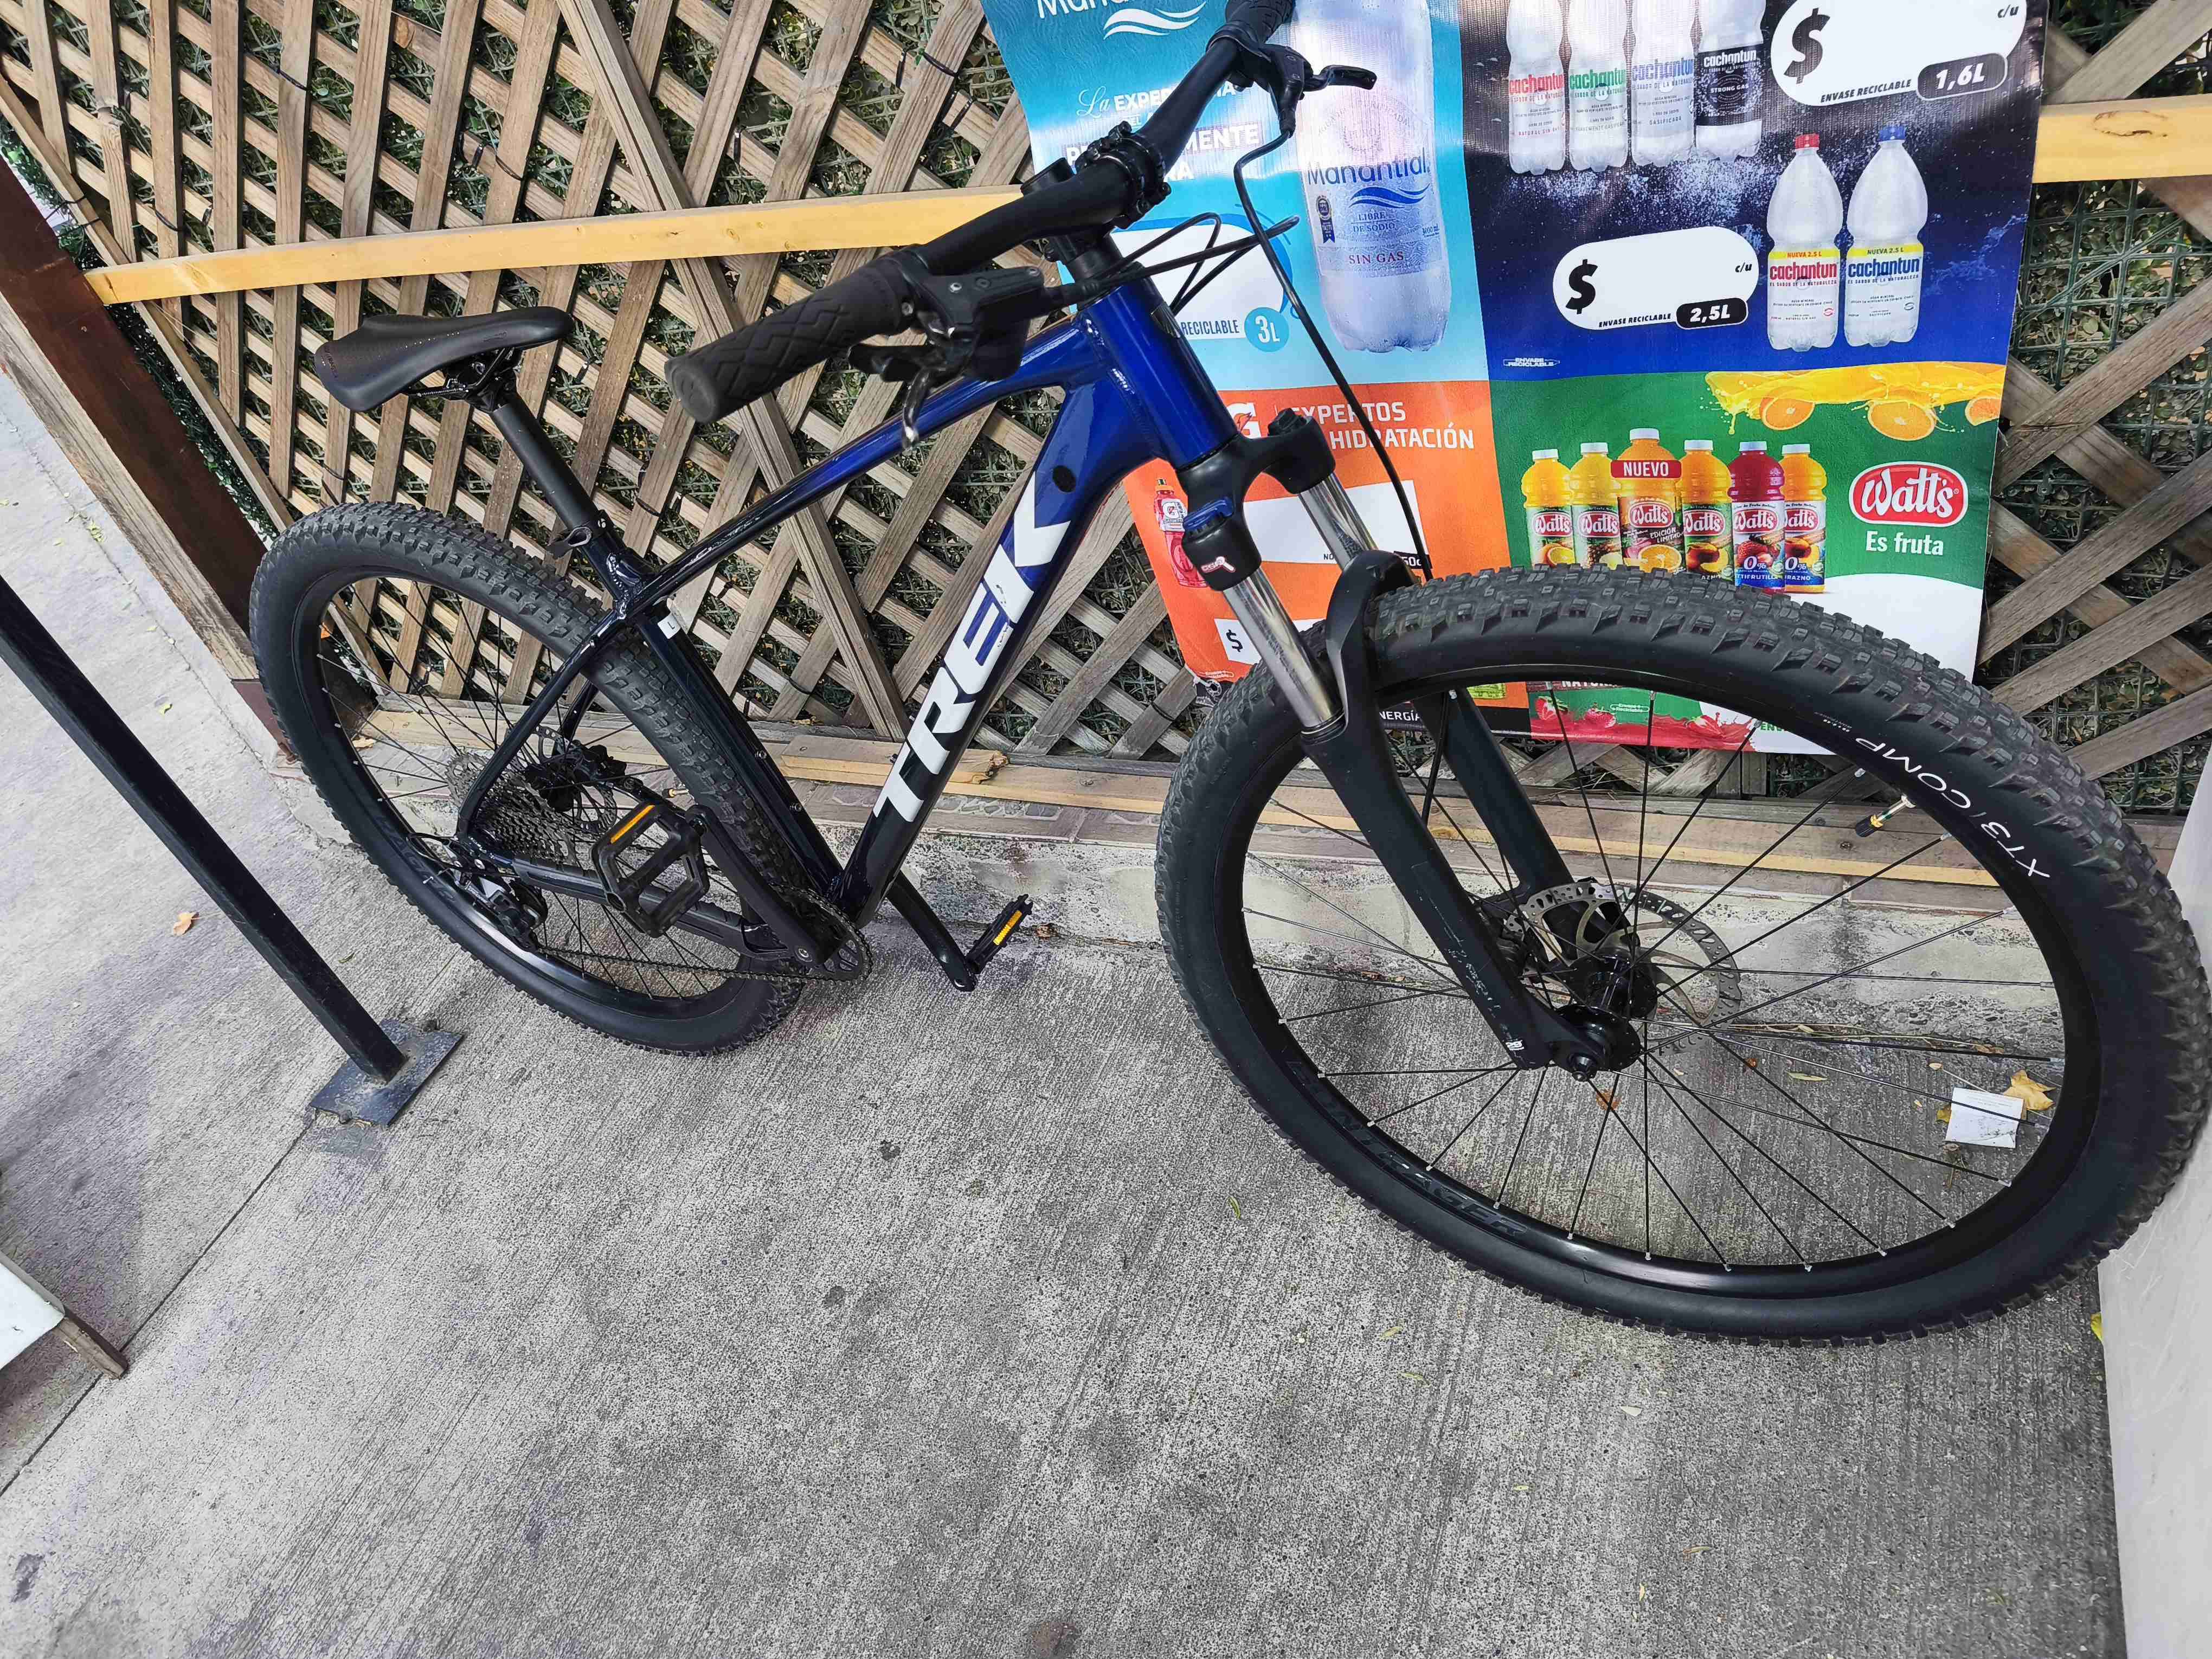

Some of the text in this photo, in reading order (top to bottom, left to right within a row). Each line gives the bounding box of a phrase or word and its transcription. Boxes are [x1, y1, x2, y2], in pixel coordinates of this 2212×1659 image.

[1997, 4, 2019, 19] c/u
[1784, 7, 1830, 84] $
[1703, 50, 1757, 67] cachantun
[1821, 62, 1984, 103] ENVASE RECICLABLE 1,6L
[1076, 86, 1110, 118] La
[1308, 147, 1427, 185] Manantial
[1358, 211, 1386, 221] LIBRE
[1366, 222, 1396, 232] SODIO
[1348, 251, 1405, 265] SIN GAS
[1735, 262, 1752, 273] c/u
[1848, 257, 1920, 278] cachantun
[1770, 261, 1837, 280] cachantun
[1566, 259, 1598, 314] $
[1598, 304, 1730, 327] ENVASE RECICLABLE 2,5L
[1180, 315, 1280, 343] RECICLABLE 3L
[1291, 402, 1406, 425] XPETOS
[1623, 462, 1669, 477] NUEVO
[1785, 510, 1816, 529] att's
[1866, 531, 1944, 556] Es fruta
[873, 471, 1071, 822] TREK
[1225, 629, 1243, 653] $
[1379, 710, 1420, 721] NERGÍA
[1855, 737, 1971, 809] COMP
